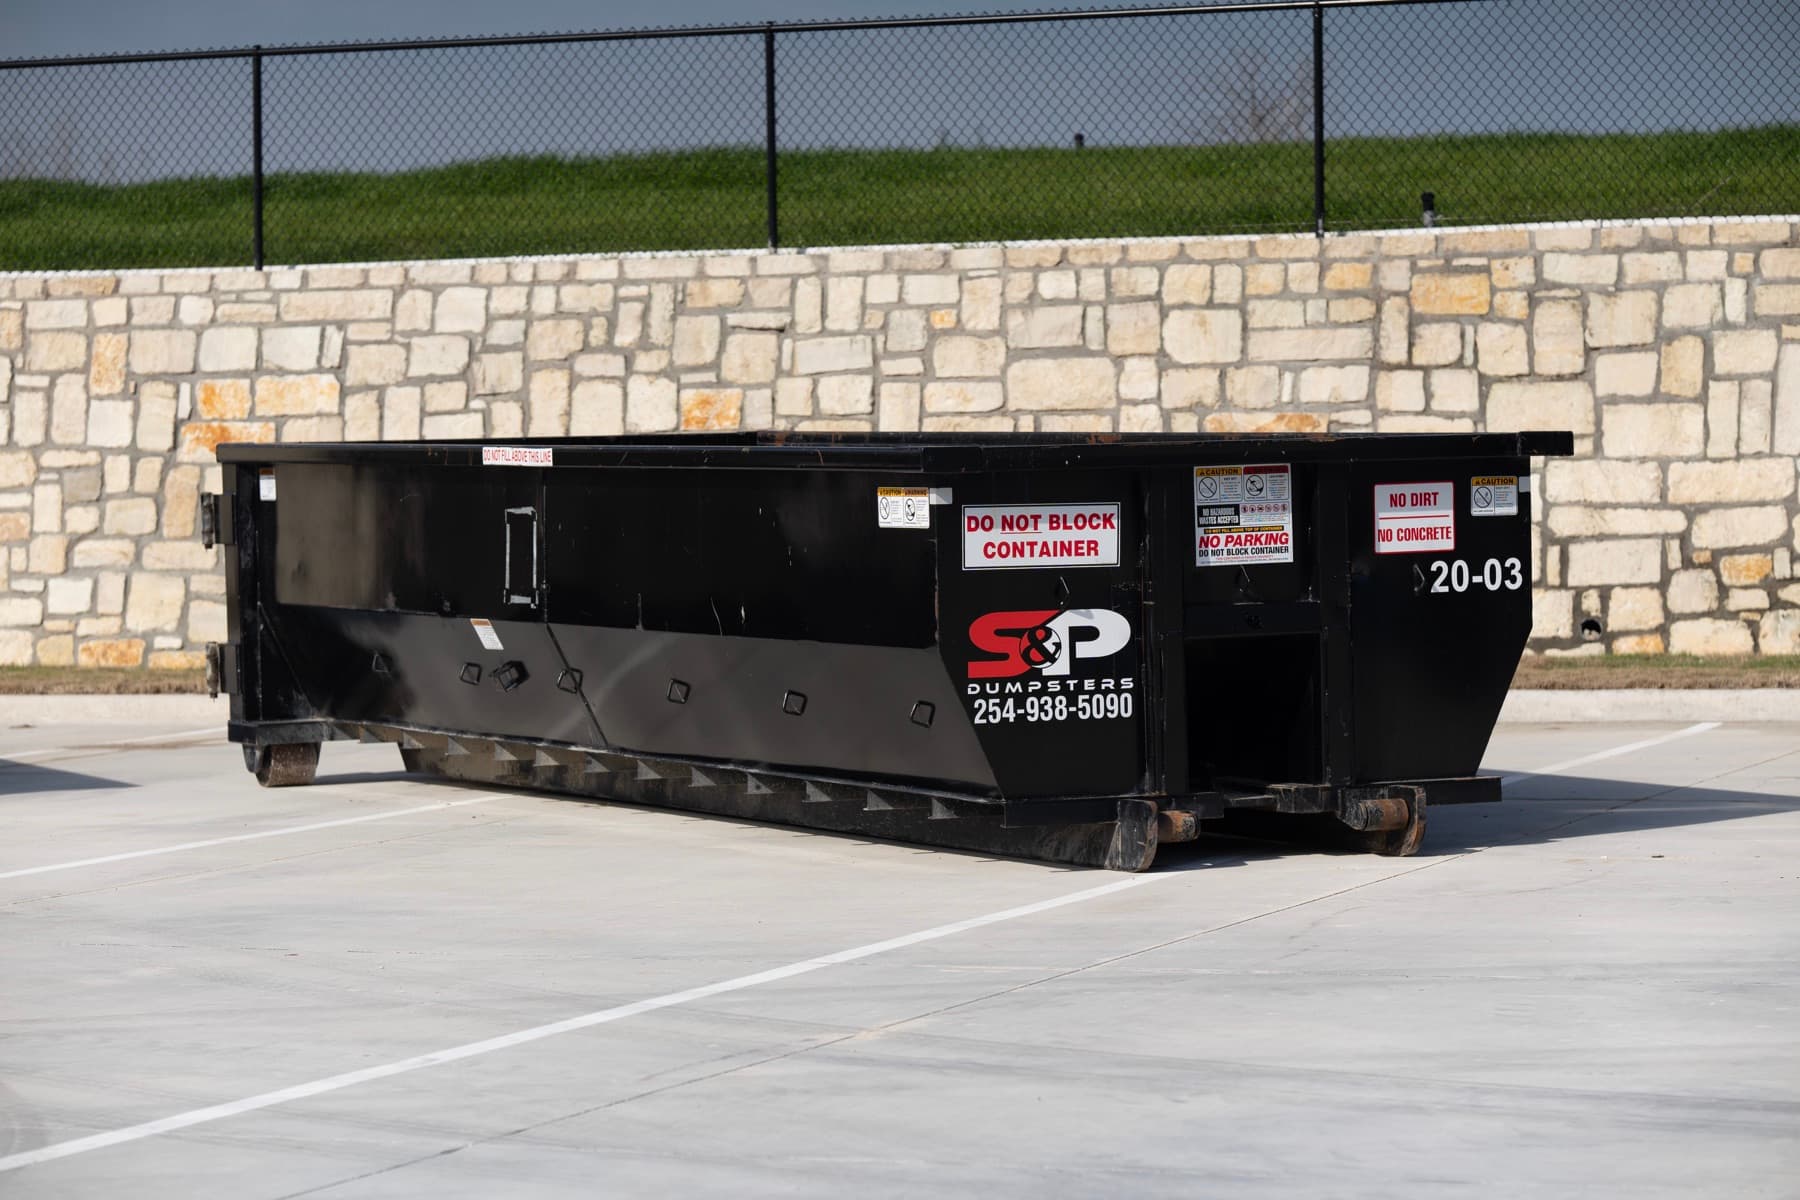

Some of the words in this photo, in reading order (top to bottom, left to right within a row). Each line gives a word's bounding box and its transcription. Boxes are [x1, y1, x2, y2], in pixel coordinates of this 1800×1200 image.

[484, 449, 490, 461] DO
[492, 449, 500, 461] NOT
[502, 450, 511, 461] FILL
[512, 450, 527, 462] ABOVE
[528, 451, 539, 463] THIS
[540, 451, 551, 463] LINE
[1390, 493, 1406, 507] NO
[1411, 492, 1439, 507] DIRT
[966, 515, 994, 532] DO
[1001, 514, 1042, 532] NOT
[1048, 513, 1116, 530] BLOCK
[1199, 536, 1220, 548] NO
[1224, 532, 1289, 547] PARKING
[1378, 529, 1392, 542] NO
[1397, 526, 1452, 541] CONCRETE
[983, 540, 1099, 559] CONTAINER
[1227, 548, 1249, 556] BLOCK
[1251, 546, 1288, 555] CONTAINER
[1430, 557, 1523, 593] 20-03
[968, 609, 1132, 679] S&P
[968, 678, 1134, 695] DUMPSTERS
[974, 692, 1133, 724] 254-938-5090
